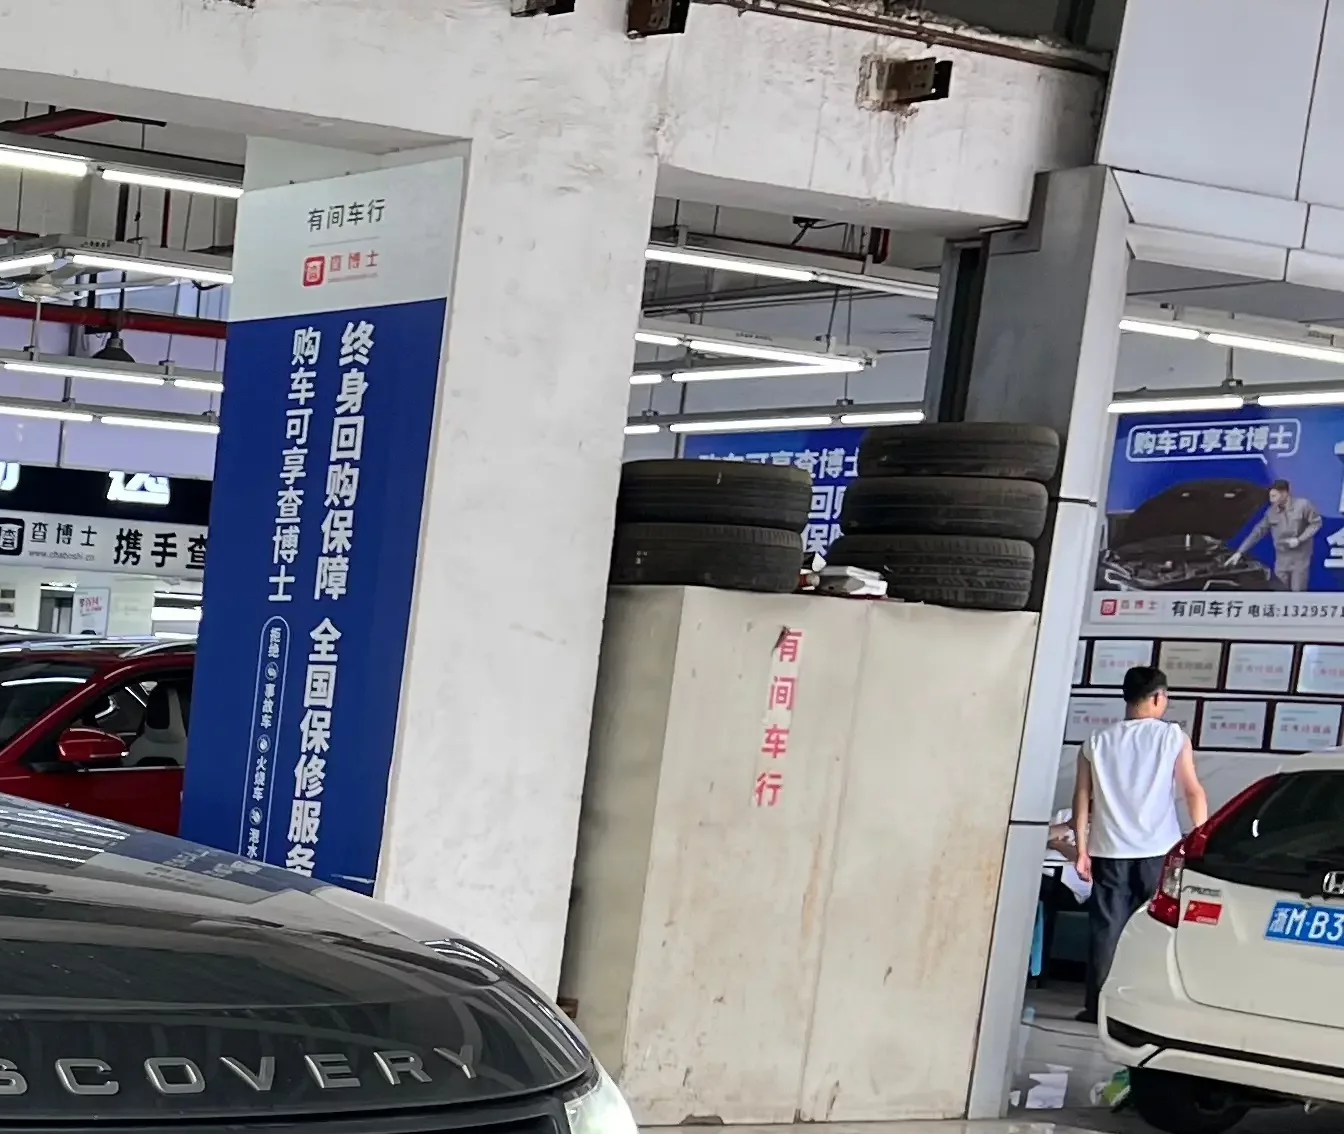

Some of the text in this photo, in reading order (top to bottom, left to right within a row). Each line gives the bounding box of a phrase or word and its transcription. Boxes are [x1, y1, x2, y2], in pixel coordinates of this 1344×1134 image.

[307, 198, 386, 233] 有间车行
[267, 326, 322, 602] 购车可享查博士
[314, 320, 375, 601] 终身回购保障
[1132, 425, 1294, 455] 购车可享查博士
[30, 521, 98, 547] 查博士
[1171, 600, 1244, 618] 有间车行
[285, 617, 343, 878] 全国保修服务
[754, 628, 803, 808] 有间车行
